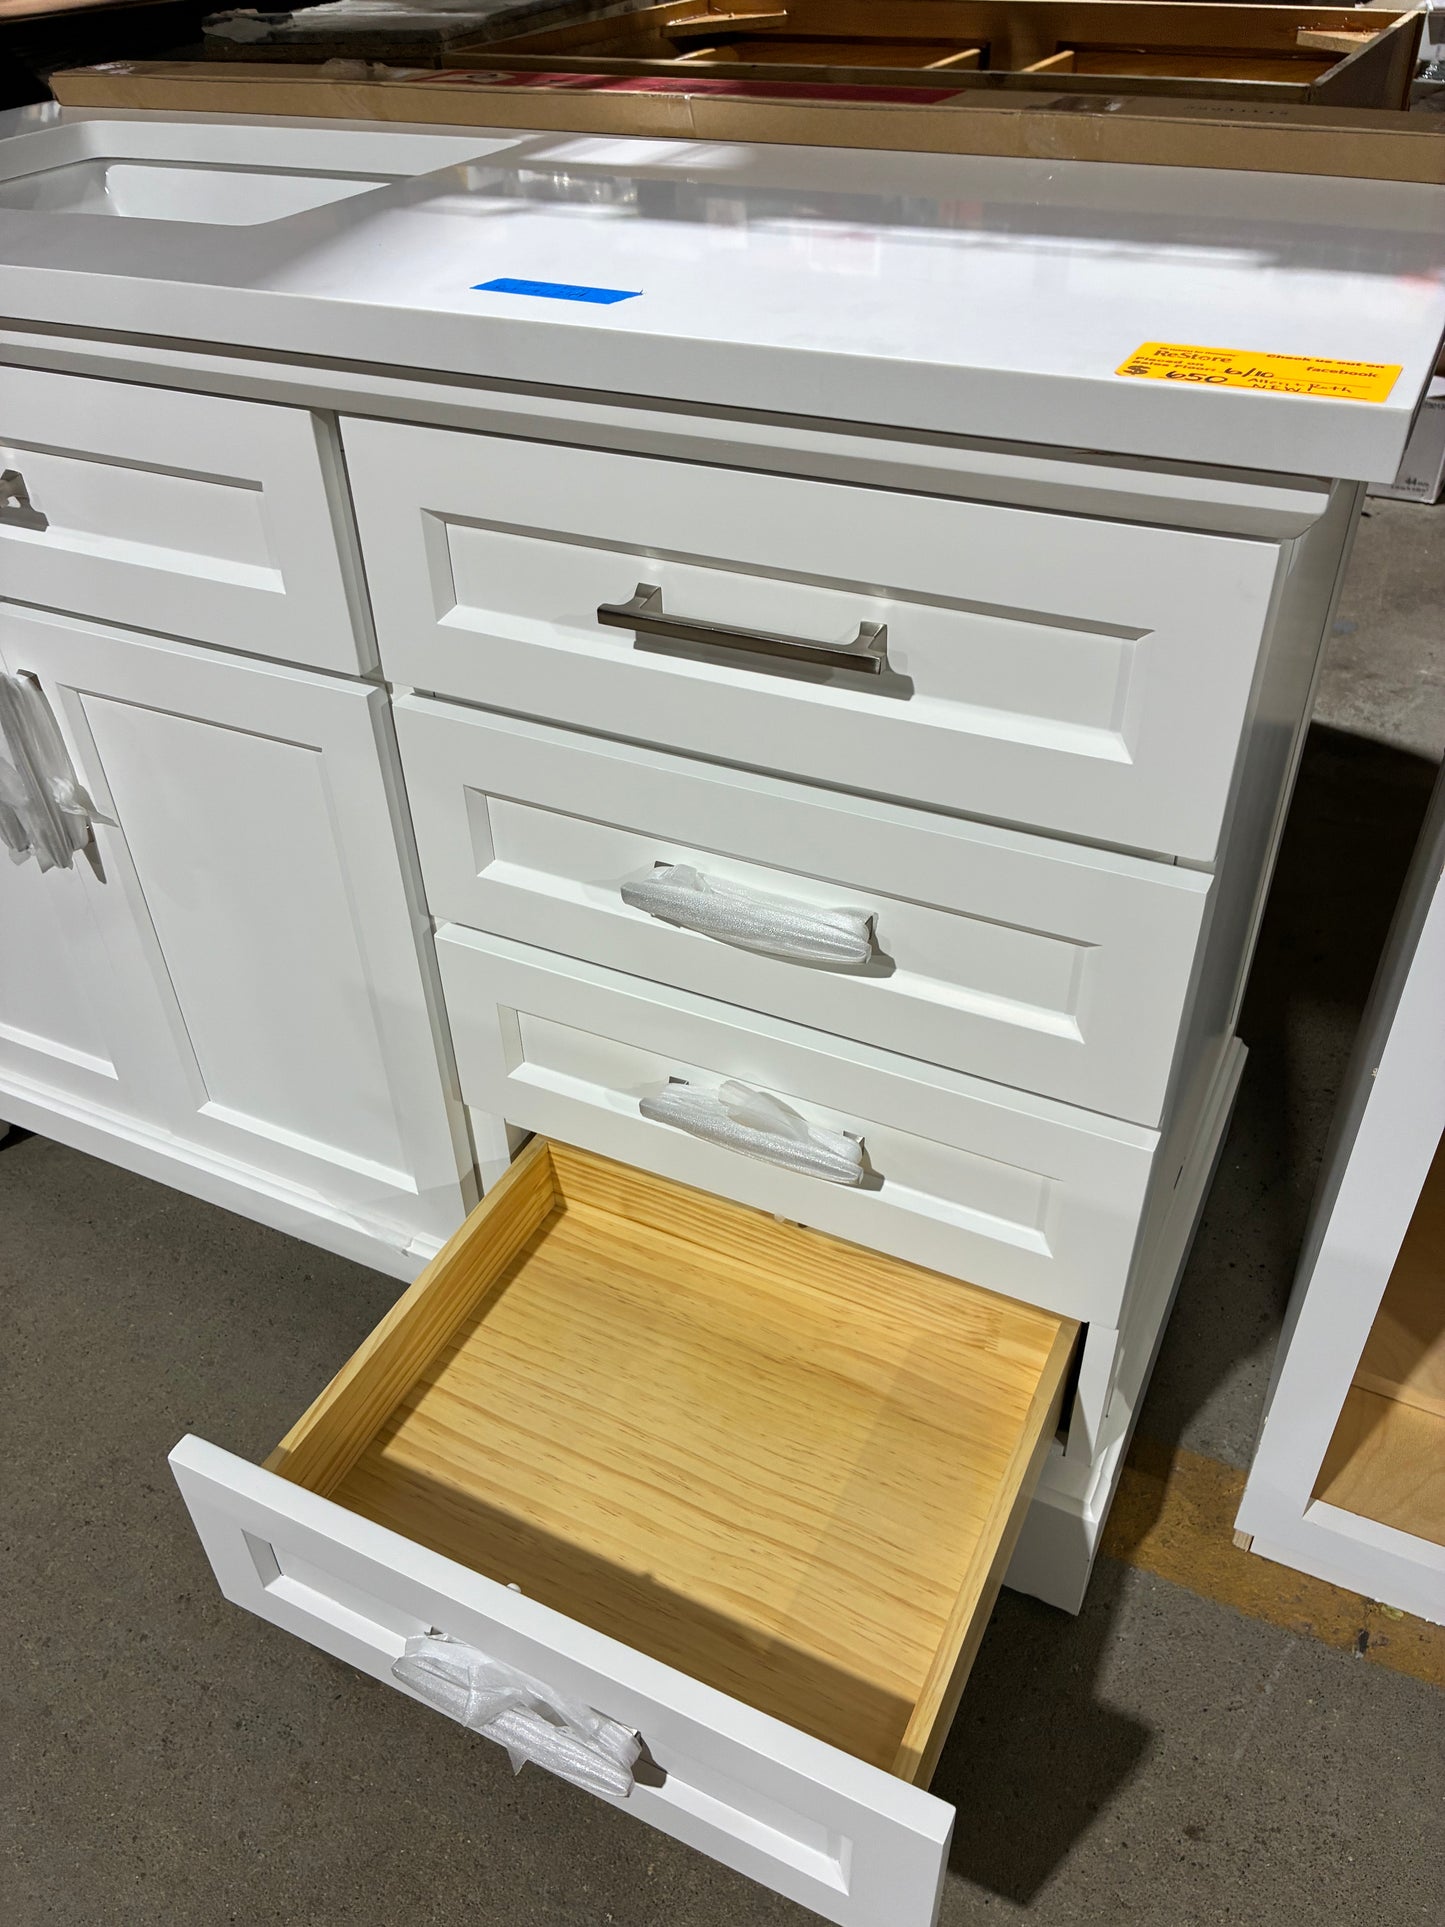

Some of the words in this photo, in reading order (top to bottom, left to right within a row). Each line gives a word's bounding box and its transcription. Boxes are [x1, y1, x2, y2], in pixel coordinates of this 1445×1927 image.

[1135, 356, 1183, 364] Placed
[1153, 349, 1232, 363] ReStore
[1266, 353, 1311, 361] Check
[1122, 365, 1151, 375] $
[1306, 366, 1379, 378] facebook
[1165, 370, 1228, 384] 650
